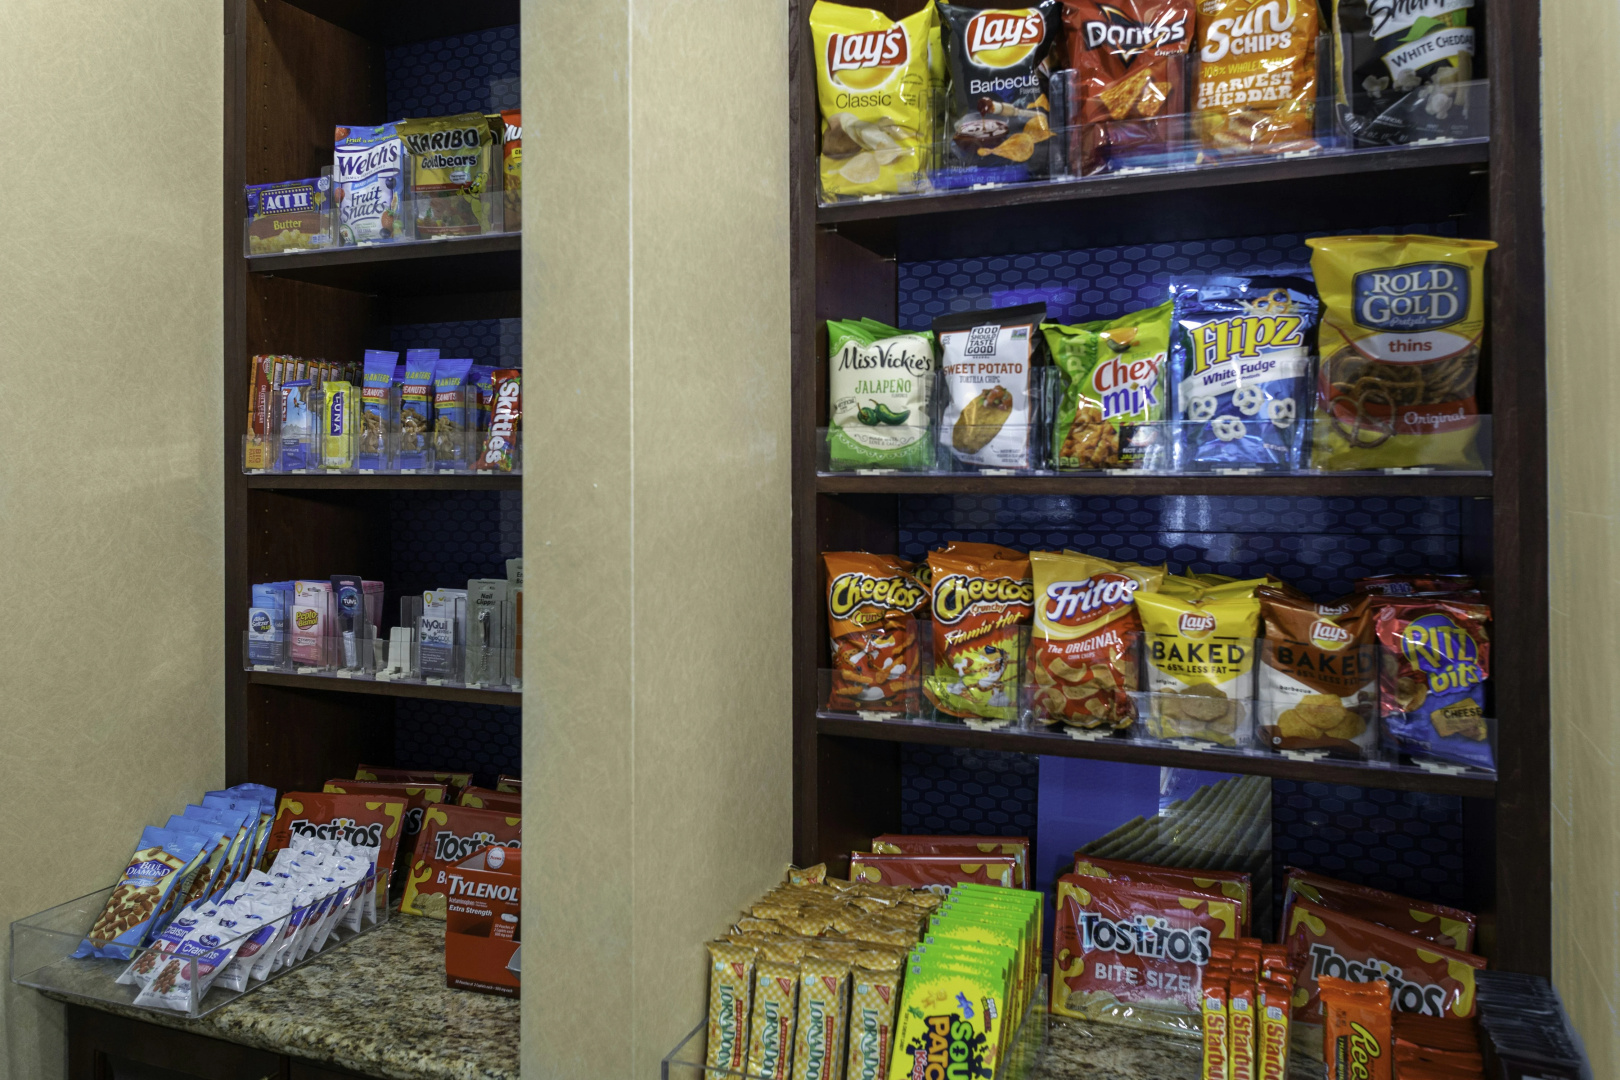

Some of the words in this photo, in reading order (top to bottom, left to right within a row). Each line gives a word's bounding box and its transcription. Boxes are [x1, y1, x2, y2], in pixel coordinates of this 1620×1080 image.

[971, 15, 1041, 52] Lay's
[1086, 20, 1185, 48] Doritos
[1200, 0, 1296, 62] Sun
[1230, 31, 1292, 55] CHIPS
[832, 28, 902, 71] Lay's
[1391, 41, 1435, 67] WHITE
[1228, 61, 1259, 74] WHOLE
[970, 74, 1040, 94] Barbecue
[1198, 71, 1294, 97] HARVEST
[835, 91, 892, 109] Classic
[1196, 85, 1293, 110] CHEDDAR
[406, 128, 479, 154] HARIBO
[337, 143, 398, 176] Welch's
[421, 154, 477, 169] Goldbears
[266, 194, 291, 210] ACT
[292, 193, 308, 207] II
[351, 186, 382, 207] Fruit
[343, 200, 387, 223] Snacks
[273, 220, 302, 230] Butter
[1372, 268, 1454, 295] ROLD
[1362, 292, 1458, 323] GOLD
[971, 327, 998, 335] FOOD
[968, 346, 994, 355] GOOD
[1190, 315, 1304, 374] Flipz
[1388, 339, 1433, 353] thins
[838, 348, 879, 371] Miss
[876, 342, 932, 377] Vickie's
[943, 363, 975, 376] SWEET
[978, 363, 1023, 374] POTATO
[1094, 352, 1164, 391] Chex
[364, 373, 390, 383] PLANTERS
[405, 371, 431, 381] PLANTERS
[435, 378, 461, 387] PLANTERS
[984, 375, 1001, 384] CHIPS
[1203, 368, 1236, 387] White
[1240, 359, 1276, 376] Fudge
[436, 392, 457, 401] EANUTS
[855, 378, 912, 394] JALAPEÑO
[1102, 378, 1157, 418] mix
[333, 396, 341, 432] LUNA
[485, 381, 519, 463] Skittles
[1403, 407, 1466, 428] Original
[830, 574, 922, 616] Cheetos
[933, 575, 1035, 623] Cheetos
[1046, 577, 1139, 622] Fritos
[971, 603, 1006, 613] Crunchy
[996, 611, 1025, 629] Hot
[421, 619, 448, 631] NyQuil
[1180, 613, 1215, 631] Lay's
[1312, 623, 1348, 640] Lay's
[1047, 643, 1063, 654] The
[1065, 630, 1120, 654] ORIGINAL
[1152, 642, 1245, 664] BAKED
[1402, 624, 1476, 670] RITZ
[1167, 663, 1184, 672] 65%
[1186, 664, 1208, 674] LESS
[1211, 666, 1227, 675] FAT
[1278, 645, 1374, 676] BAKED
[1429, 663, 1481, 691] bits
[1279, 685, 1312, 695] barbecue
[1443, 706, 1482, 720] CHEESE
[126, 866, 171, 877] DIAMOND
[140, 861, 163, 871] BLUE
[448, 875, 519, 902] TYLENOL
[449, 905, 465, 913] Extra
[465, 907, 493, 917] Strength
[1077, 912, 1212, 965] TOSTITOS
[1094, 963, 1139, 985] BITE
[1146, 969, 1192, 993] SIZE
[718, 984, 735, 1030] LORNA
[762, 1000, 780, 1047] LORNA
[807, 1000, 825, 1047] LORNA
[861, 1008, 879, 1056] LORNA
